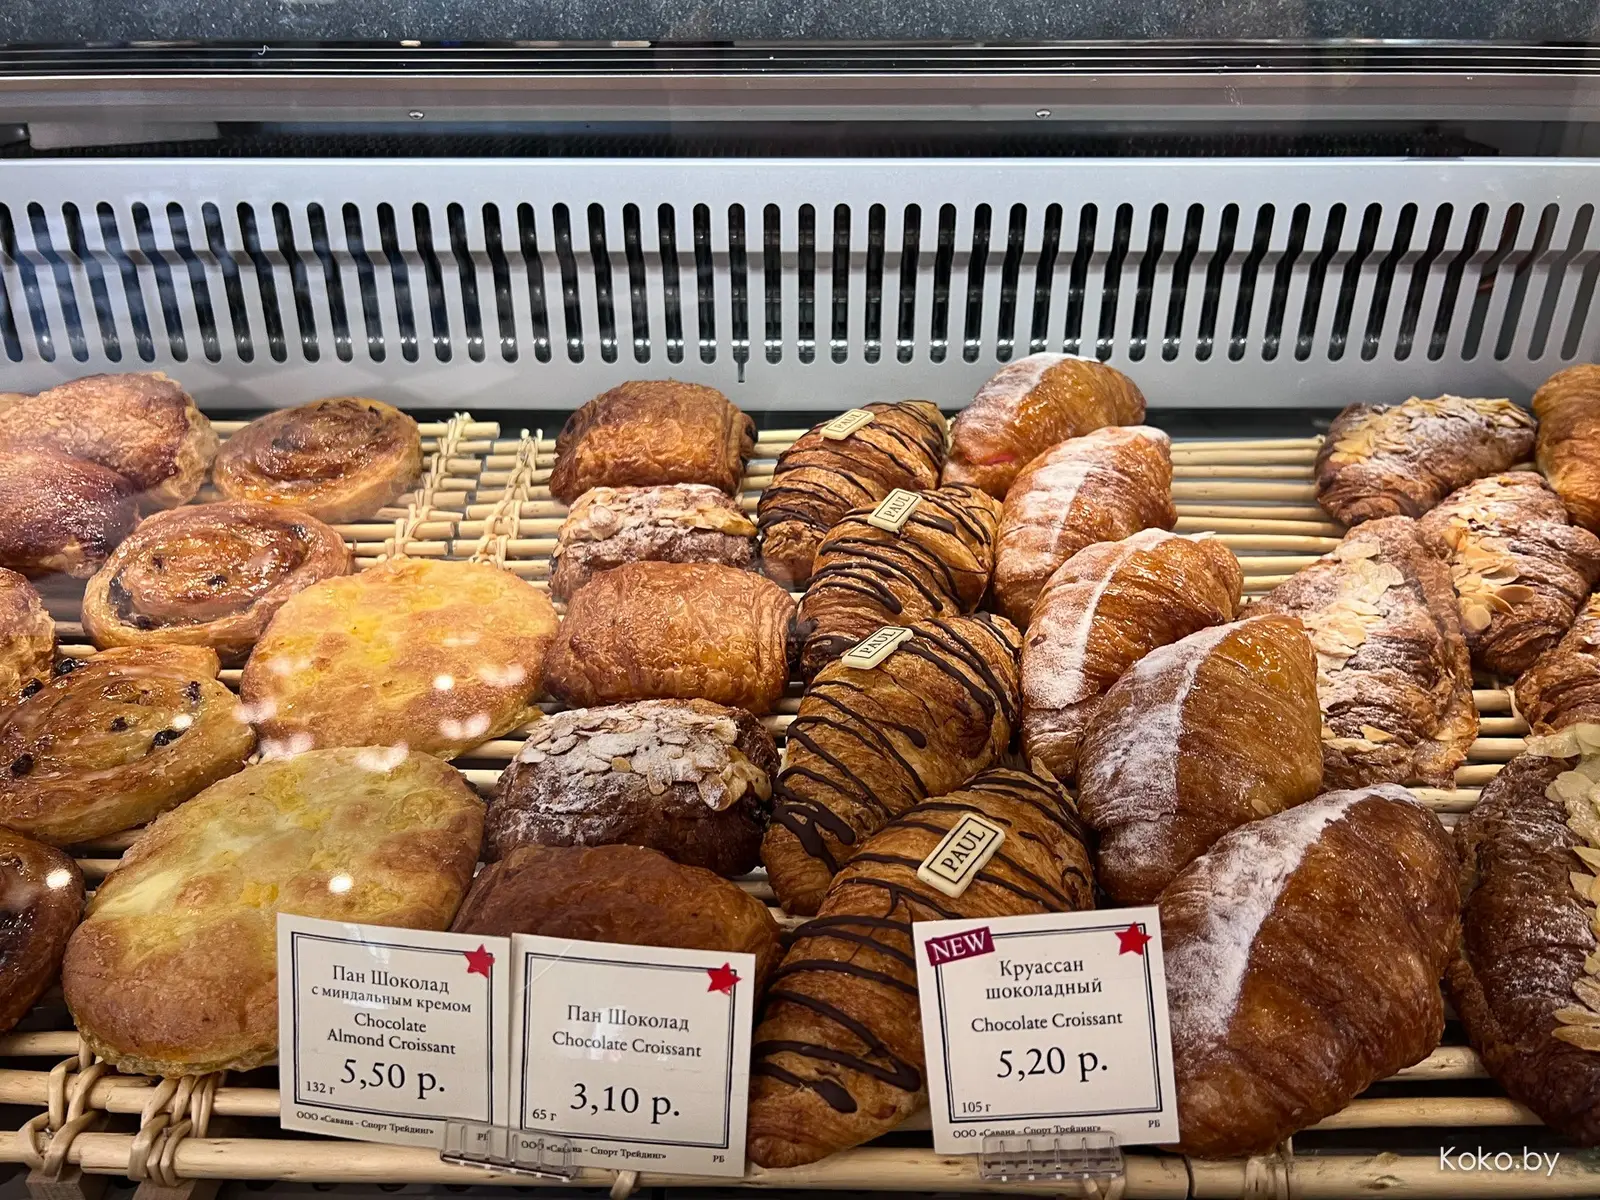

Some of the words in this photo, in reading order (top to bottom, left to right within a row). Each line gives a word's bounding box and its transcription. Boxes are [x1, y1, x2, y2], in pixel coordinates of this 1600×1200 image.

[834, 413, 862, 429] PAUL
[884, 496, 911, 518] PAUL
[859, 632, 895, 653] PAUL
[941, 830, 985, 872] PAUL
[931, 932, 985, 961] NEW
[332, 965, 365, 983] Пан
[371, 970, 449, 994] Шоколад
[1000, 958, 1084, 981] Круассан
[312, 986, 318, 995] с
[322, 988, 412, 1007] миндальным
[417, 999, 471, 1013] кремом
[986, 978, 1103, 1000] шоколадный
[354, 1013, 426, 1033] Chocolate
[567, 1005, 601, 1022] Пан
[608, 1009, 689, 1032] Шоколад
[971, 1015, 1048, 1032] Chocolate
[1052, 1012, 1123, 1028] Croissant
[327, 1029, 384, 1047] Almond
[389, 1036, 456, 1055] Croissant
[552, 1031, 627, 1051] Chocolate
[632, 1039, 702, 1057] Croissant
[340, 1059, 405, 1089] 5,50
[997, 1047, 1065, 1081] 5,20
[306, 1081, 326, 1094] 132
[570, 1083, 639, 1115] 3,10
[962, 1102, 982, 1112] 105
[532, 1109, 547, 1120] 65
[1148, 1120, 1160, 1128] РБ
[361, 1120, 387, 1132] Спорт
[590, 1147, 618, 1156] Спорт
[713, 1155, 725, 1163] РБ
